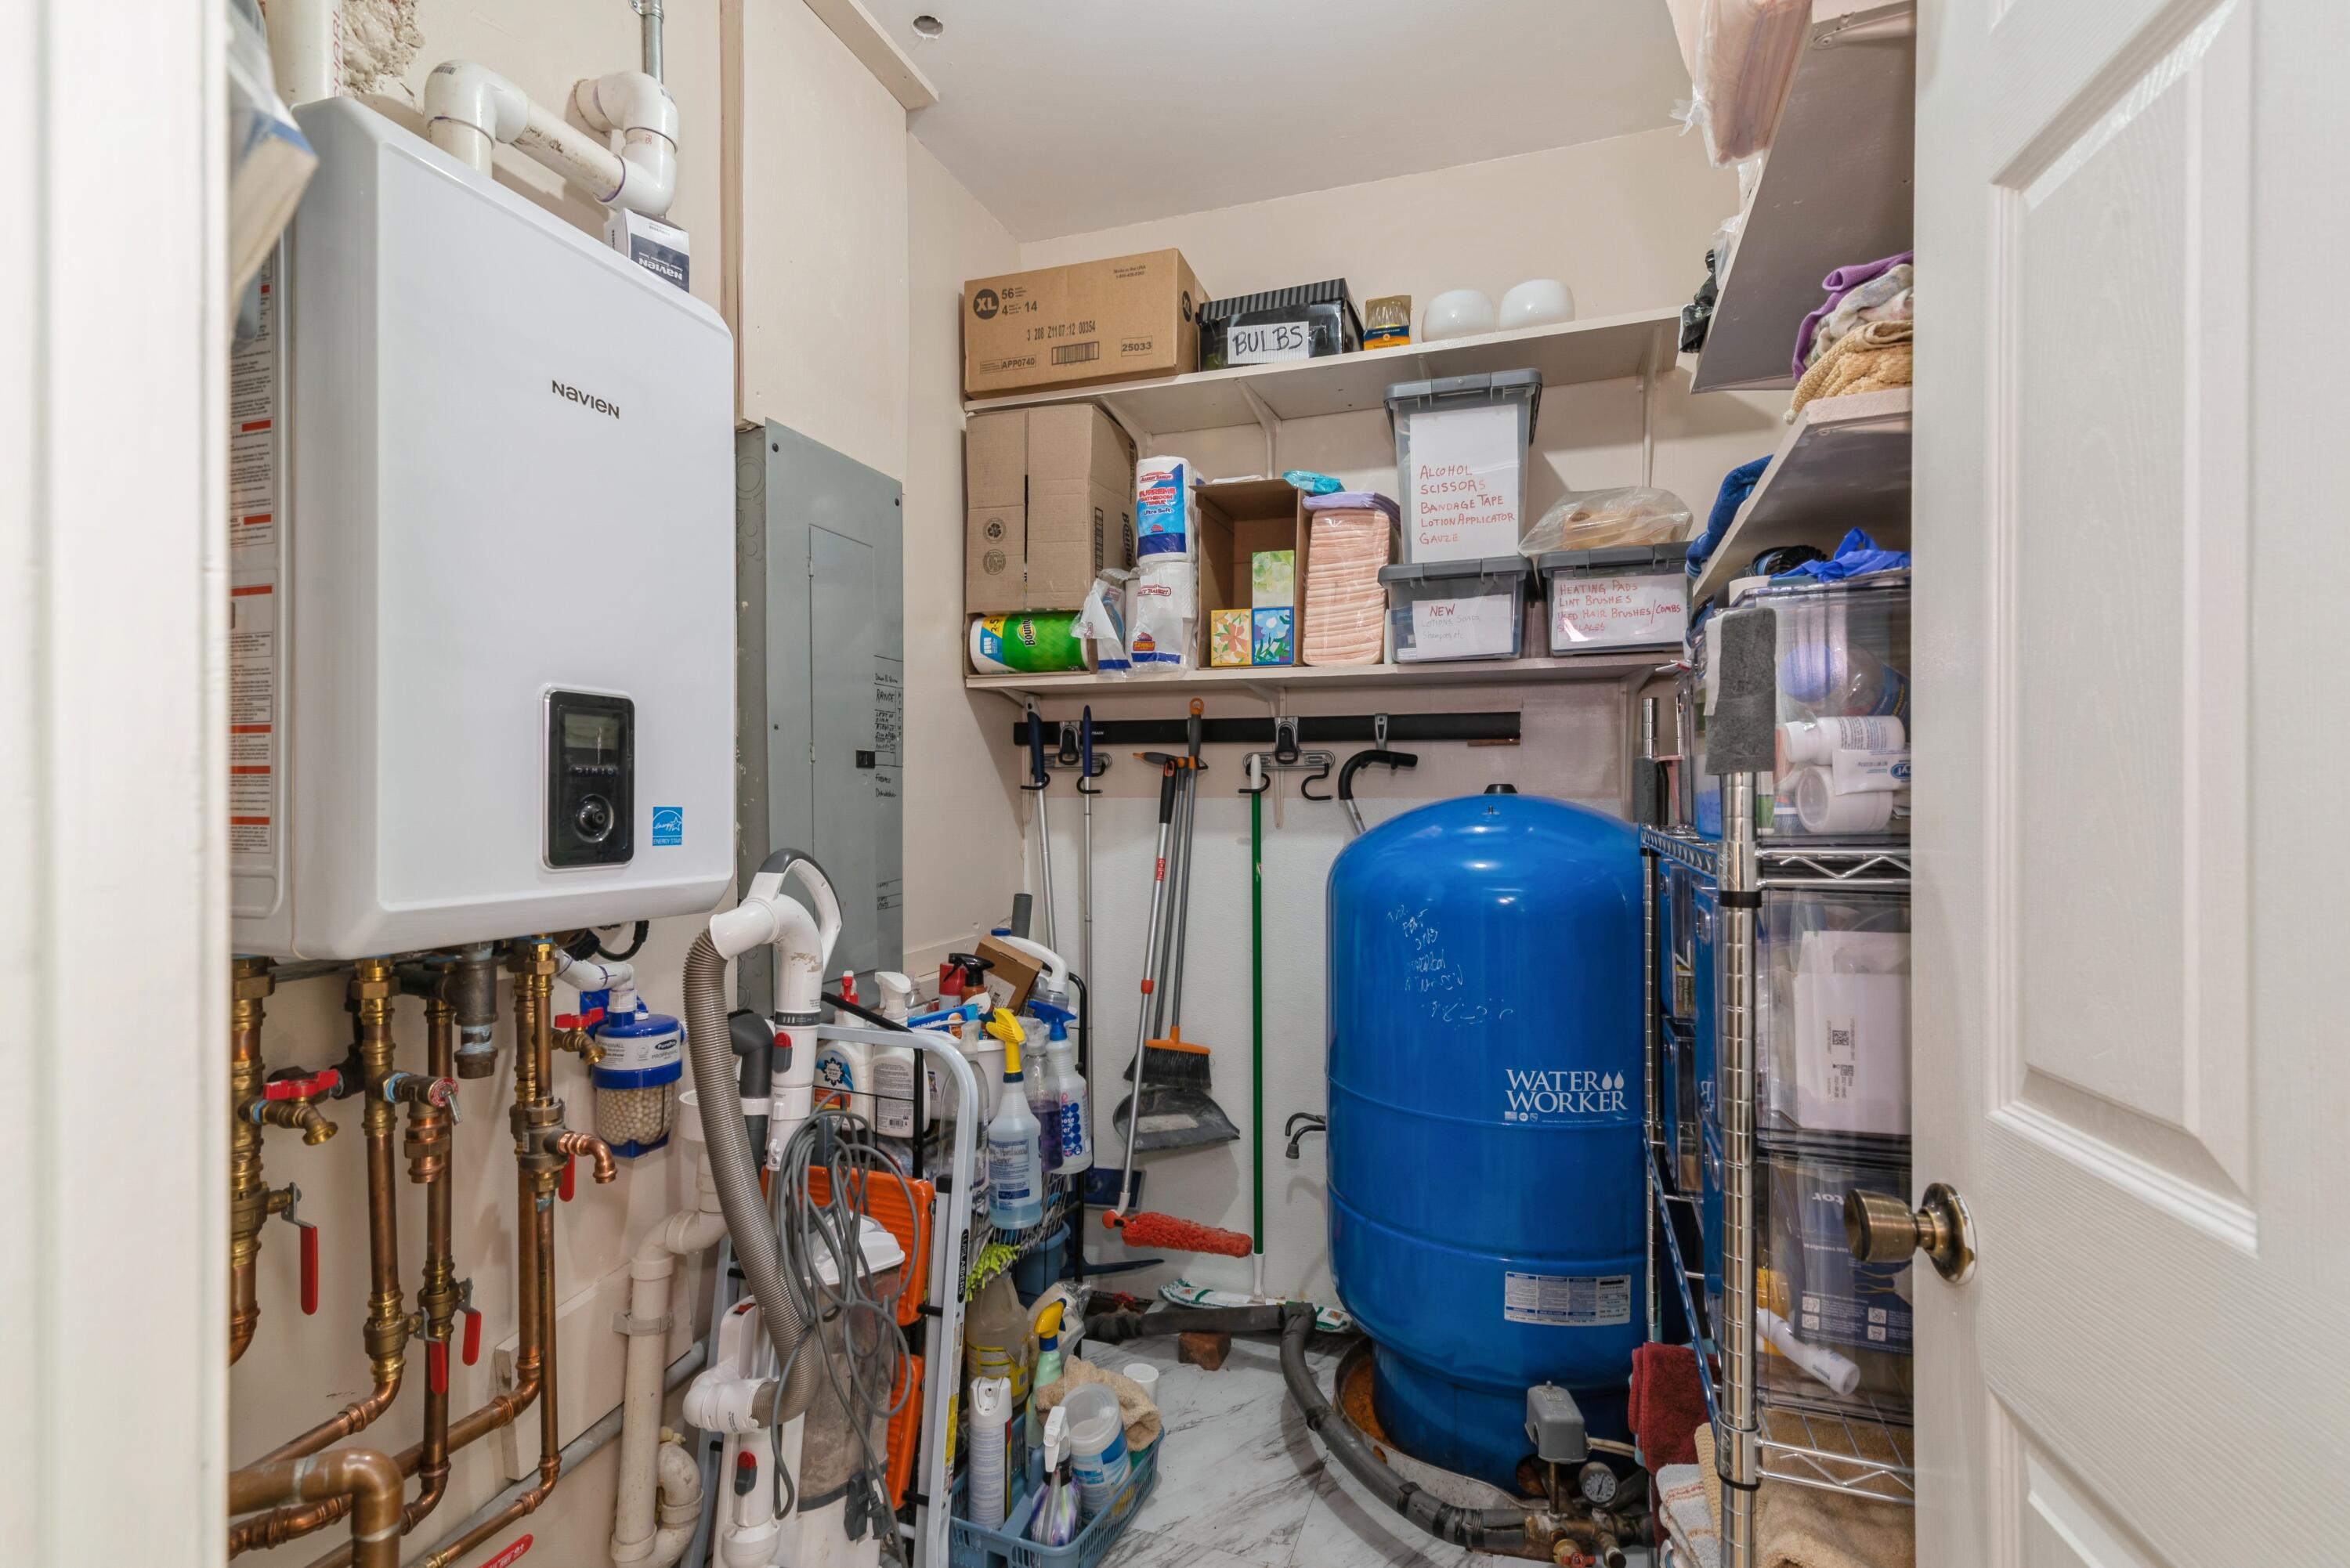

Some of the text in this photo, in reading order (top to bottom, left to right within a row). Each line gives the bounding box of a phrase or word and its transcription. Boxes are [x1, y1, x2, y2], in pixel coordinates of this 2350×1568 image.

[1002, 287, 1014, 299] 56
[976, 296, 998, 313] XL
[1002, 305, 1008, 316] 4
[1025, 301, 1037, 313] 14
[1027, 329, 1031, 341] 3
[1034, 327, 1044, 339] 208
[1079, 320, 1096, 334] 00354
[1122, 341, 1152, 352] 25033
[1232, 326, 1303, 356] BULBS
[1001, 357, 1035, 369] APP0740
[1420, 464, 1472, 479] ALCOHOL
[1139, 487, 1177, 497] SUPREME
[1421, 479, 1486, 494] SCISSORS
[1421, 494, 1504, 514] BANDAGE TAPE
[1421, 513, 1515, 527] LOTION APPLICATOR
[1419, 533, 1459, 544] GAUZE
[1560, 580, 1638, 595] HEATING PADS
[1430, 603, 1455, 616] NEW
[1560, 598, 1580, 607] LINT
[1583, 609, 1607, 619] HAIR
[1024, 618, 1036, 646] Bounty
[1505, 1069, 1603, 1091] WATER
[1505, 1089, 1629, 1113] WORKER
[1803, 1242, 1836, 1252] Walgreens
